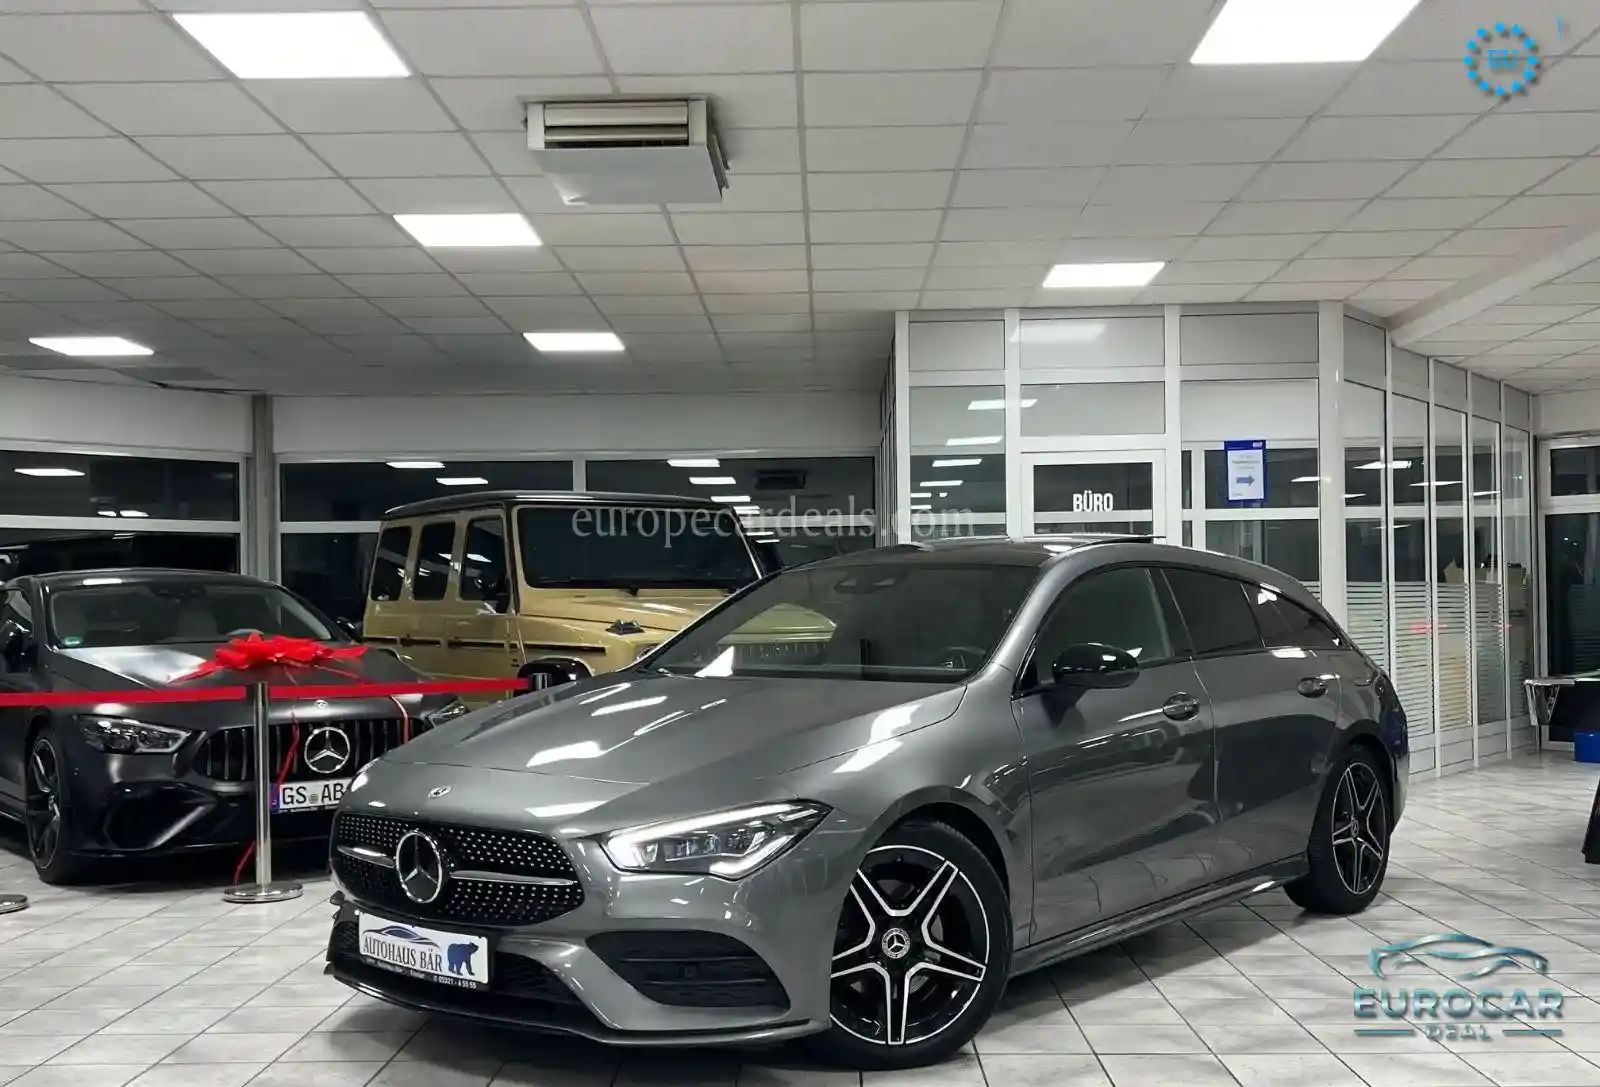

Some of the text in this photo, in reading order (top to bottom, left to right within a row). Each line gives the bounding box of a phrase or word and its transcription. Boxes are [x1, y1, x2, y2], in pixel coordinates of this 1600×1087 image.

[1072, 490, 1114, 513] BÜRO
[282, 782, 345, 805] GS AB
[363, 935, 416, 967] AUTOHAUS
[419, 947, 444, 973] BÄR
